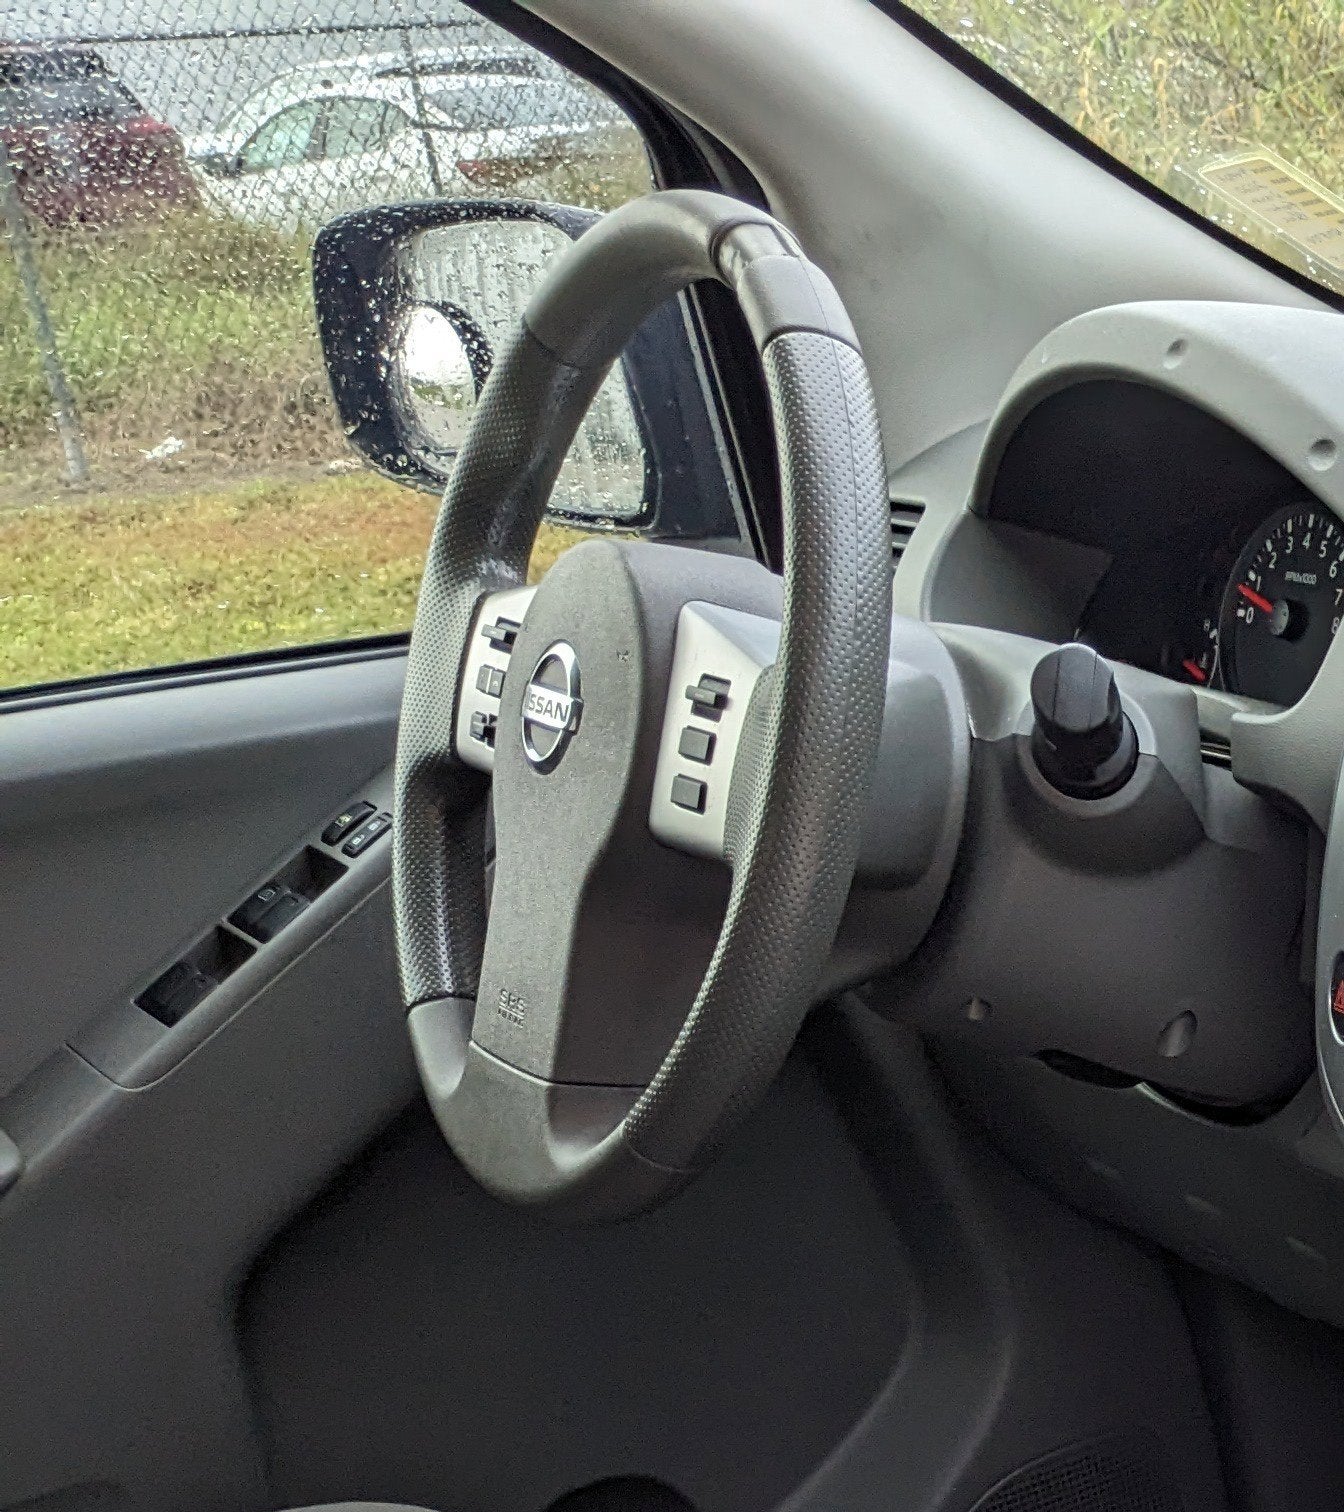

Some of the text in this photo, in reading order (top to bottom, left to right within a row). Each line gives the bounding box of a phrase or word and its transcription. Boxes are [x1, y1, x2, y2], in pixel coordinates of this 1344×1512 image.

[1285, 536, 1294, 554] 3
[1302, 532, 1312, 550] 4
[1318, 540, 1328, 558] 5
[1268, 552, 1277, 569] 2
[1329, 560, 1338, 578] 6
[1335, 588, 1343, 606] 7
[1245, 606, 1254, 624] 0
[1331, 616, 1340, 634] 8
